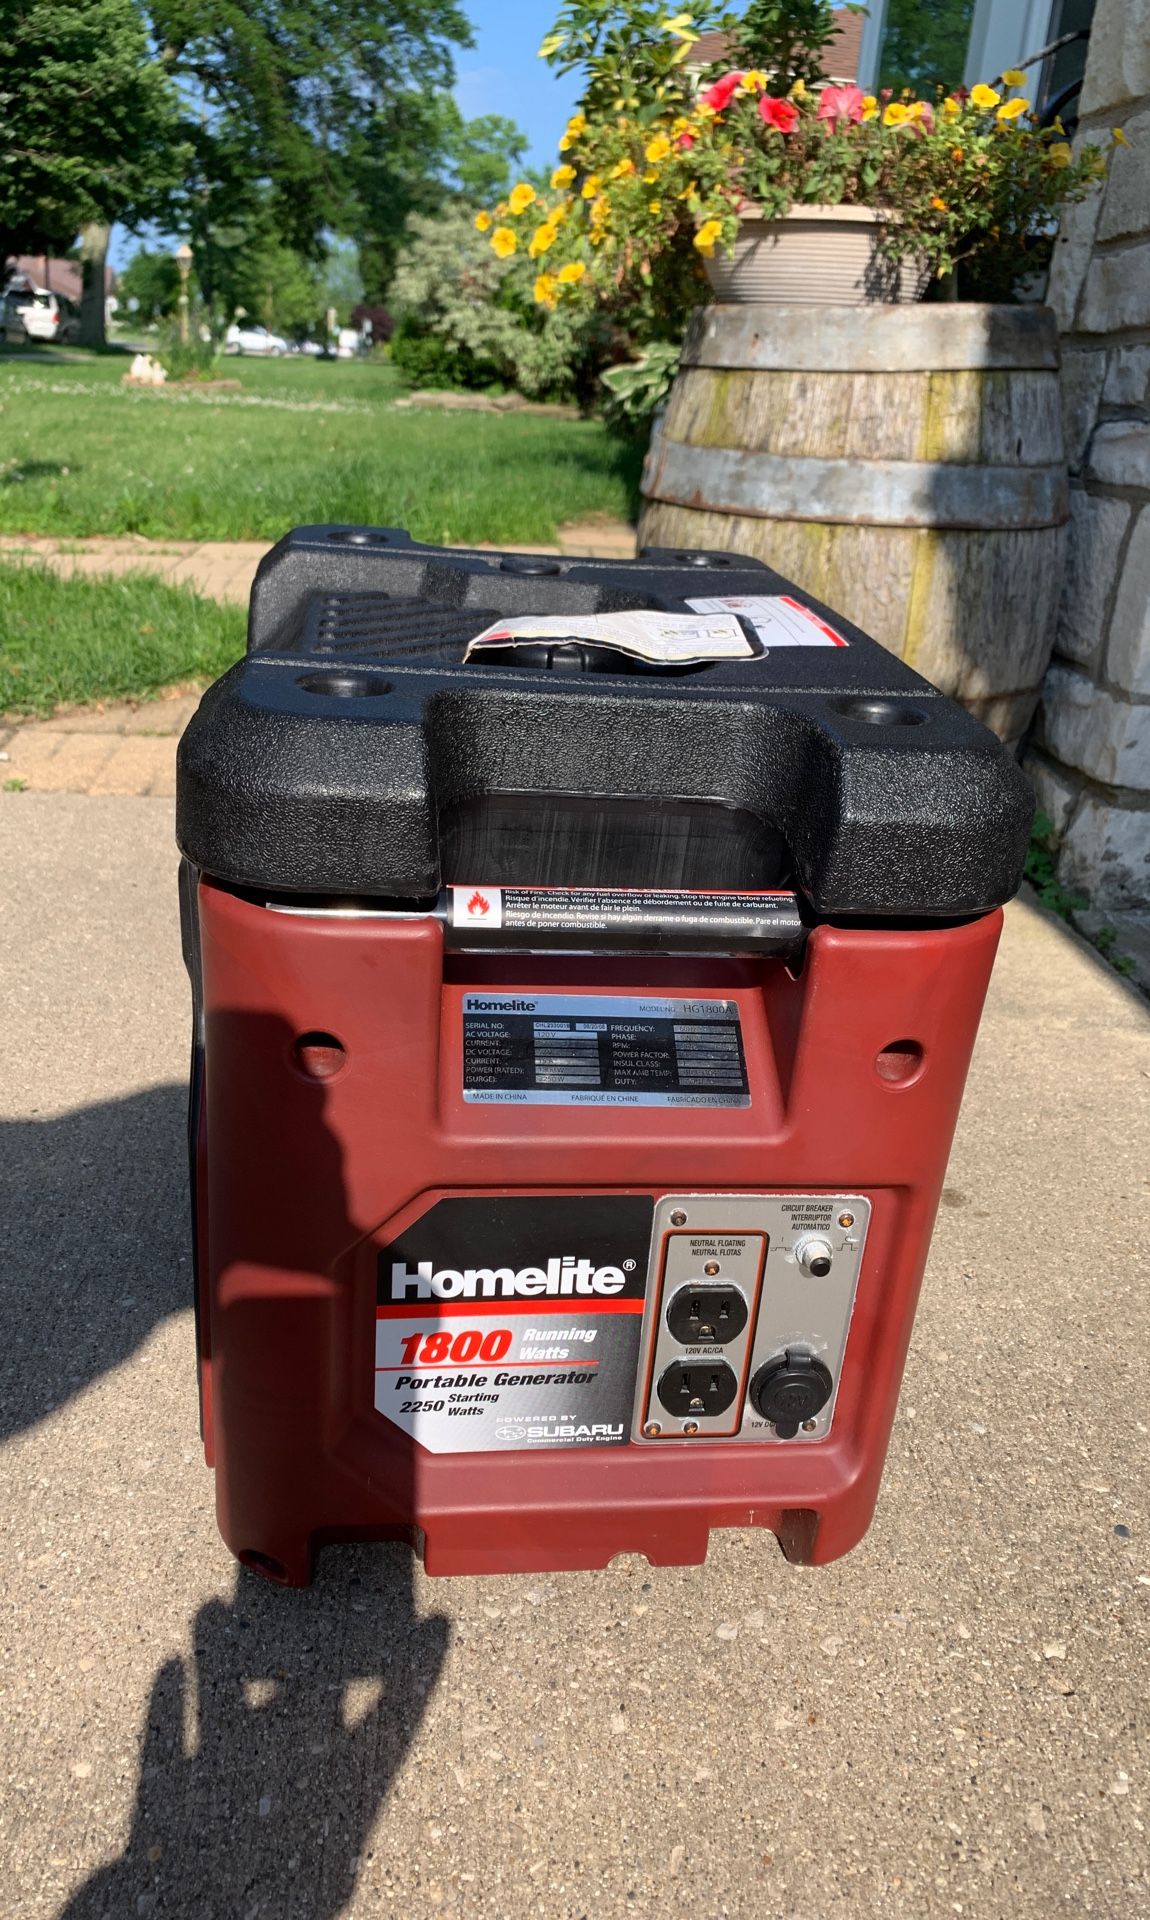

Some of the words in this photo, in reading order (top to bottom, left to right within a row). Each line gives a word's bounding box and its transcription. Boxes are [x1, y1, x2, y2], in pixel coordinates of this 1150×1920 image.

[506, 895, 530, 903] Risque
[622, 905, 642, 913] plein.
[506, 911, 530, 919] Riesgo
[608, 913, 620, 922] hay
[622, 913, 642, 922] algún
[682, 915, 698, 924] fuga
[684, 1005, 733, 1014] HG1800A
[572, 1094, 604, 1102] FABRIQUÉ
[667, 1096, 706, 1104] FABRICADO
[781, 1204, 804, 1212] CIRCUIT
[806, 1204, 833, 1212] BREAKER
[692, 1248, 718, 1256] NEUTRAL
[720, 1248, 742, 1256] FLOTAS
[522, 1327, 598, 1343] Running
[400, 1330, 513, 1365] 1800
[519, 1346, 570, 1360] Watts
[395, 1373, 488, 1390] Portable
[494, 1371, 598, 1387] Generator
[448, 1392, 500, 1404] Starting
[400, 1400, 444, 1414] 2250
[448, 1406, 484, 1416] Watts
[527, 1424, 624, 1438] SUBARU
